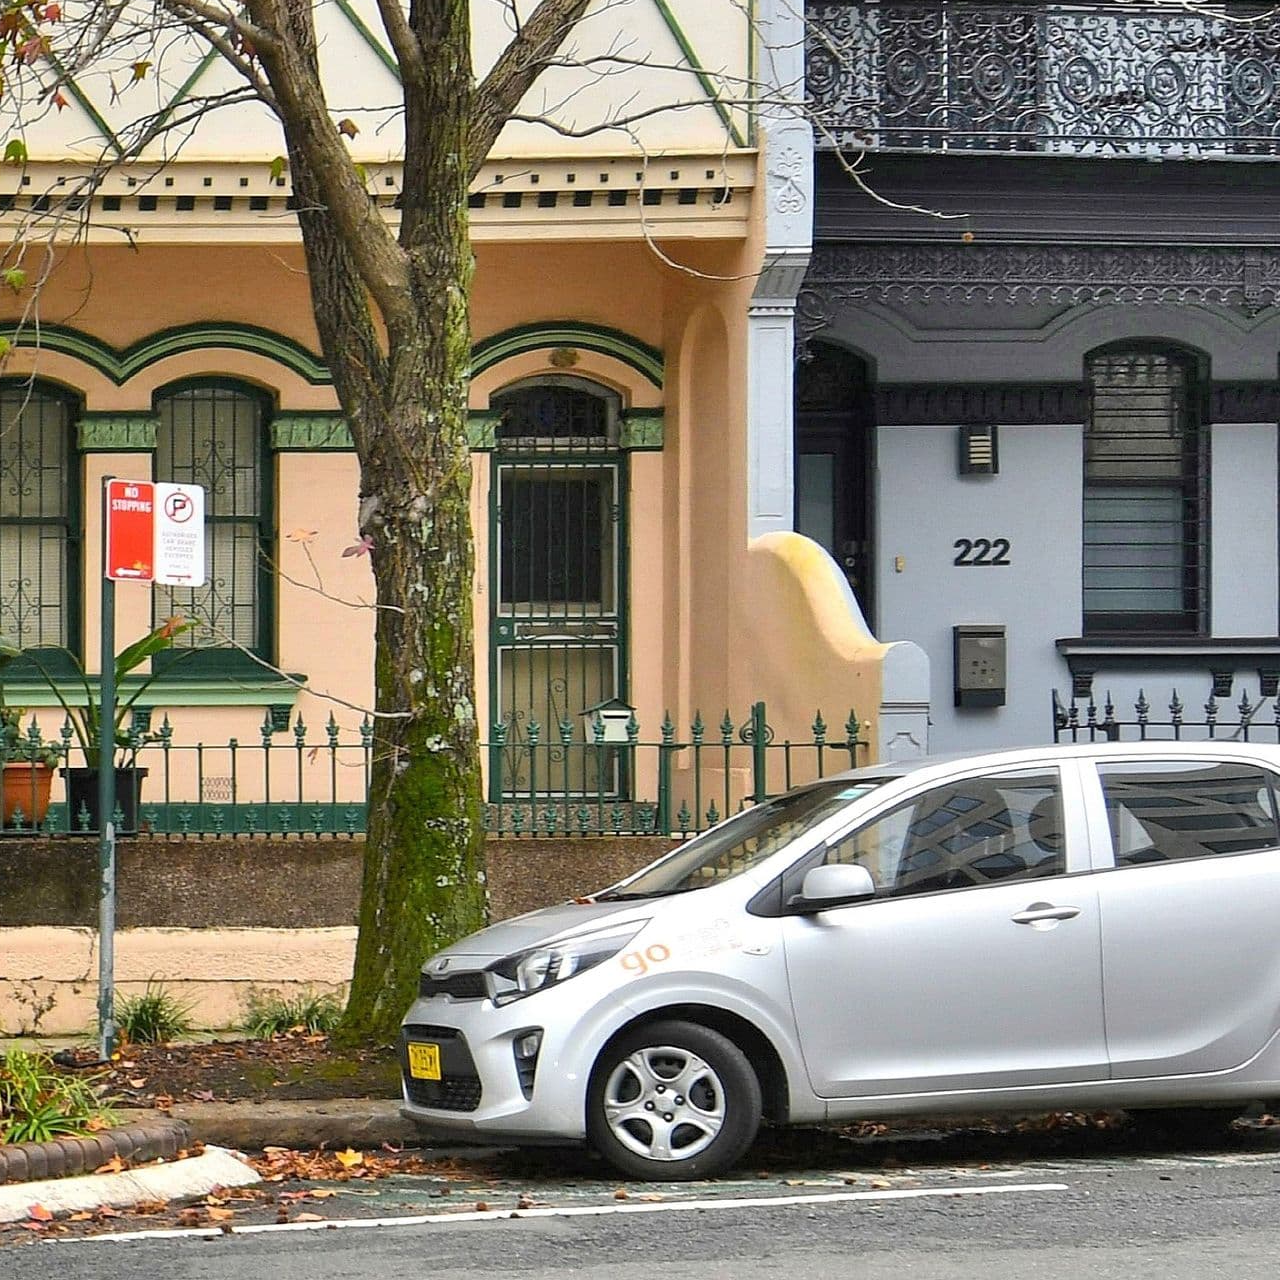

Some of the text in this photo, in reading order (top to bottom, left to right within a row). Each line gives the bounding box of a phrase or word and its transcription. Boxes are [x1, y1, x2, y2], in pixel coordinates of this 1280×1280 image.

[124, 487, 139, 497] NO
[112, 499, 152, 513] STOPPING
[953, 538, 1011, 567] 222
[620, 943, 671, 977] go
